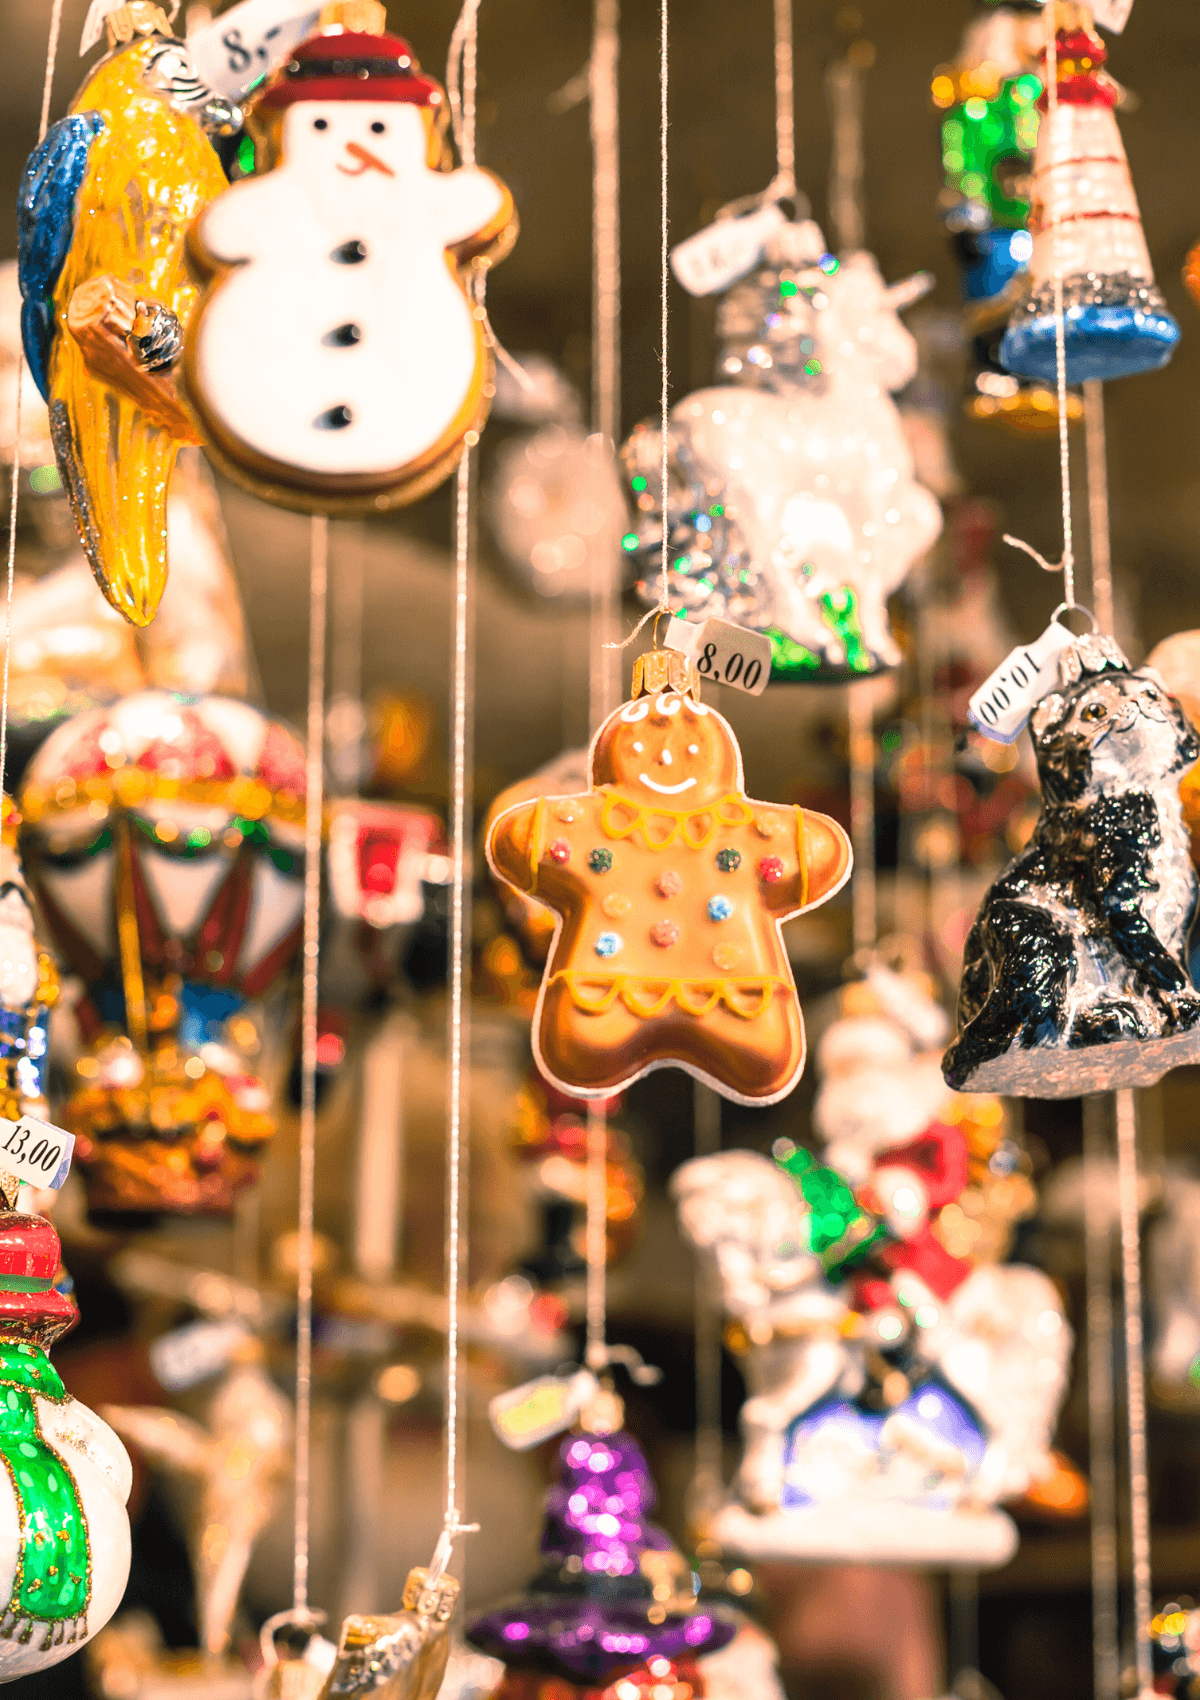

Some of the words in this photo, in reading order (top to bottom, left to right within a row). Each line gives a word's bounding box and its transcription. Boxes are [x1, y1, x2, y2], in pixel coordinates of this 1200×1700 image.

[697, 643, 762, 690] 8,00
[979, 652, 1040, 726] 10,00
[1, 1125, 61, 1172] 13,00
